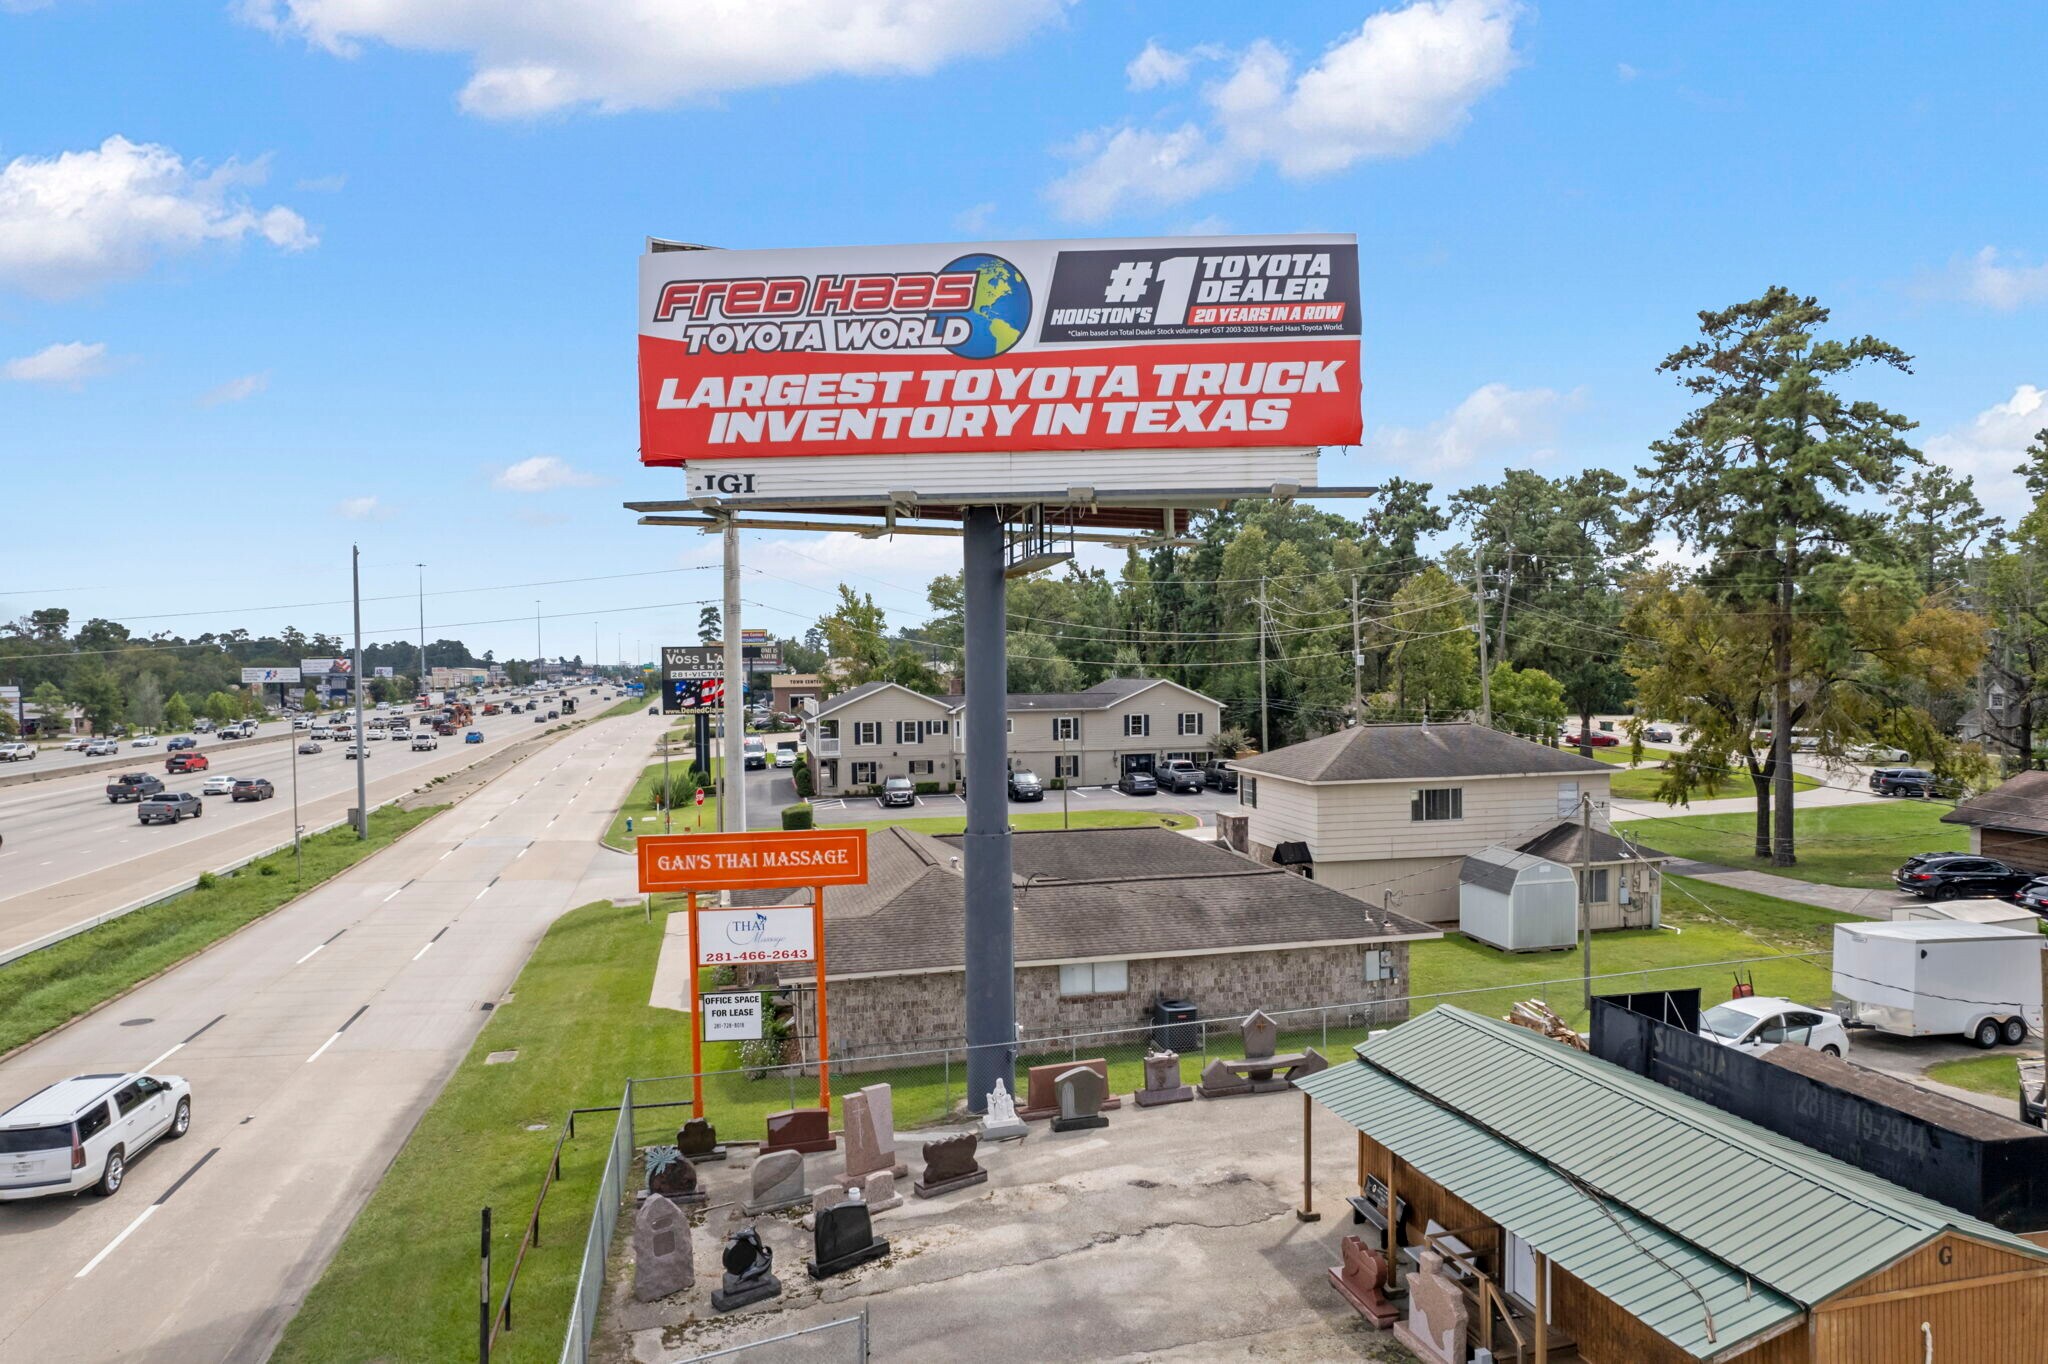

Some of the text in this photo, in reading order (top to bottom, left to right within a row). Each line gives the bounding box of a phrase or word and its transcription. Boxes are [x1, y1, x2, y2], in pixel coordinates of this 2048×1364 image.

[1202, 253, 1331, 279] TOYOTA
[1104, 256, 1200, 325] #1
[1197, 277, 1329, 303] DEALER
[1050, 307, 1153, 326] HOUSTON'S
[1193, 305, 1340, 323] 20 YEARS IN A ROW
[685, 317, 971, 354] TOYOTA WORLD
[1301, 324, 1322, 333] Toyota
[657, 360, 1346, 410] LARGEST TOYOTA TRUCK
[708, 398, 1291, 444] INVENTORY IN TEXAS
[706, 653, 724, 664] LA
[657, 849, 849, 871] GAN'S THAI MASSAGE
[706, 949, 808, 962] 281-466-2643
[705, 995, 760, 1005] OFFICE SPACE
[711, 1008, 754, 1017] FOR LEASE
[1938, 1245, 1954, 1267] G
